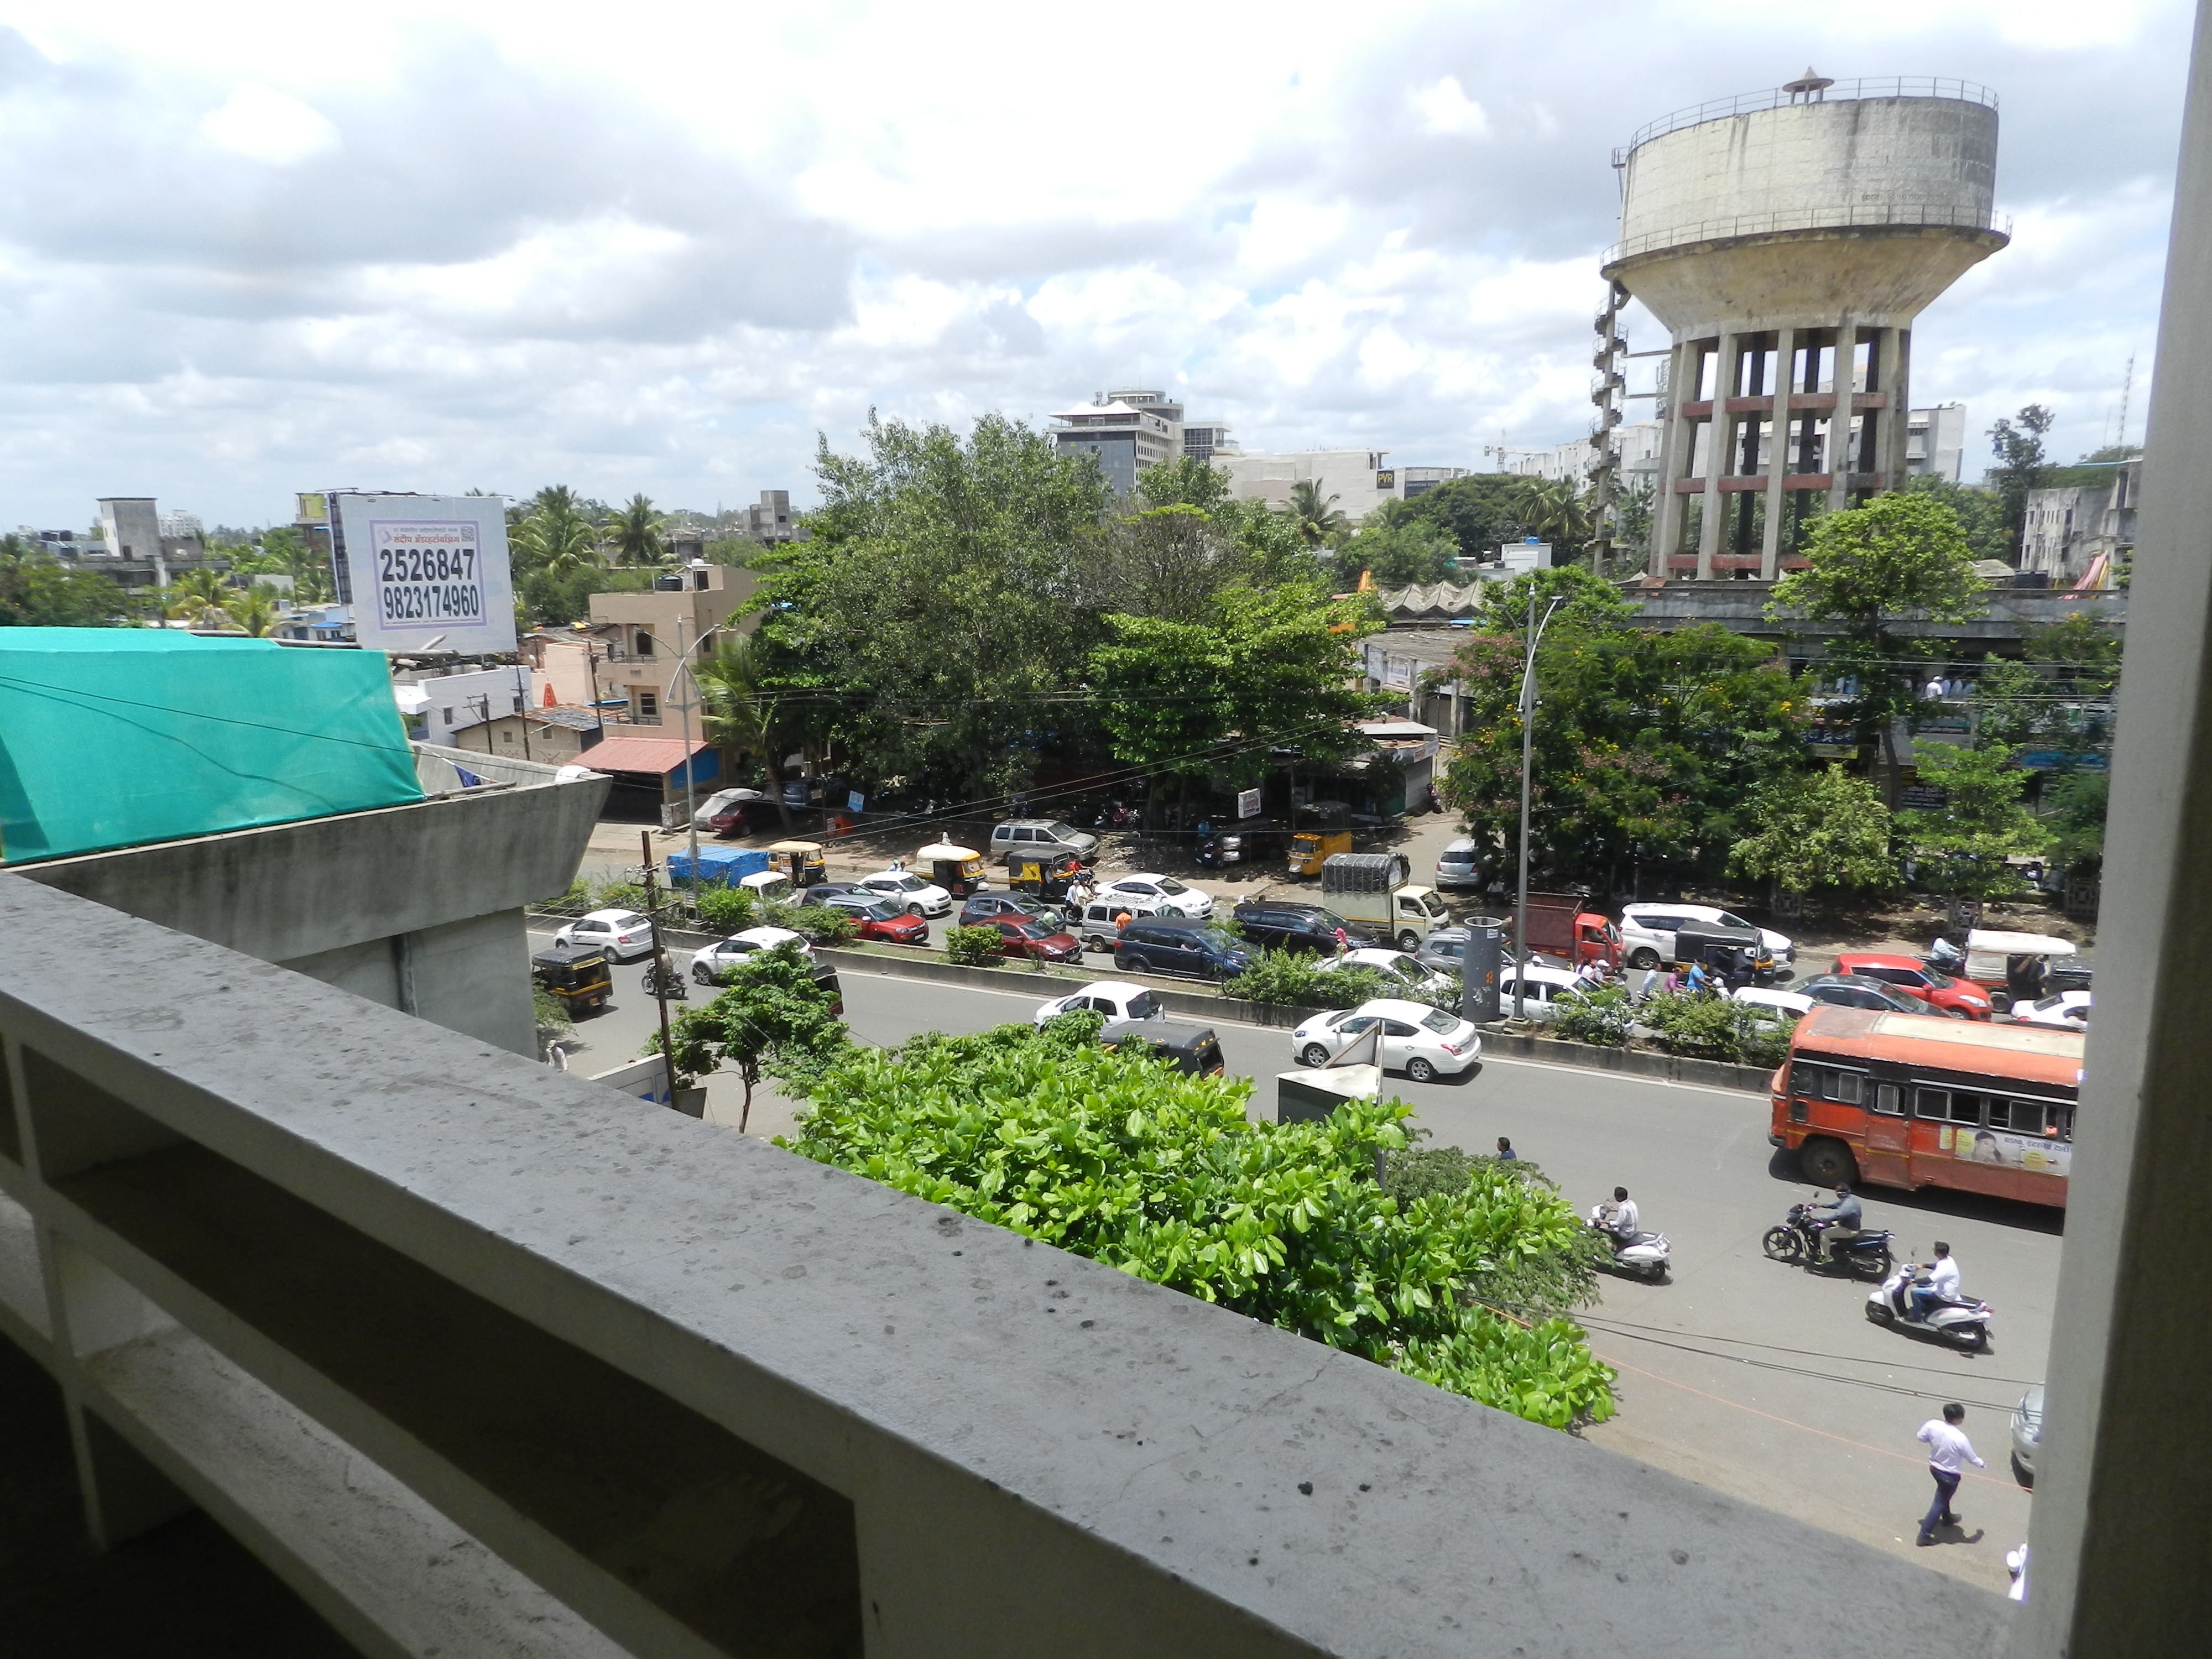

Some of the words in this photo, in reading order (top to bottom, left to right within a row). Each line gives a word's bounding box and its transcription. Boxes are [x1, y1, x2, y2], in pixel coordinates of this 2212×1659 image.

[1378, 473, 1392, 483] PVR
[380, 549, 474, 582] 2526847
[384, 585, 479, 619] 9823174960
